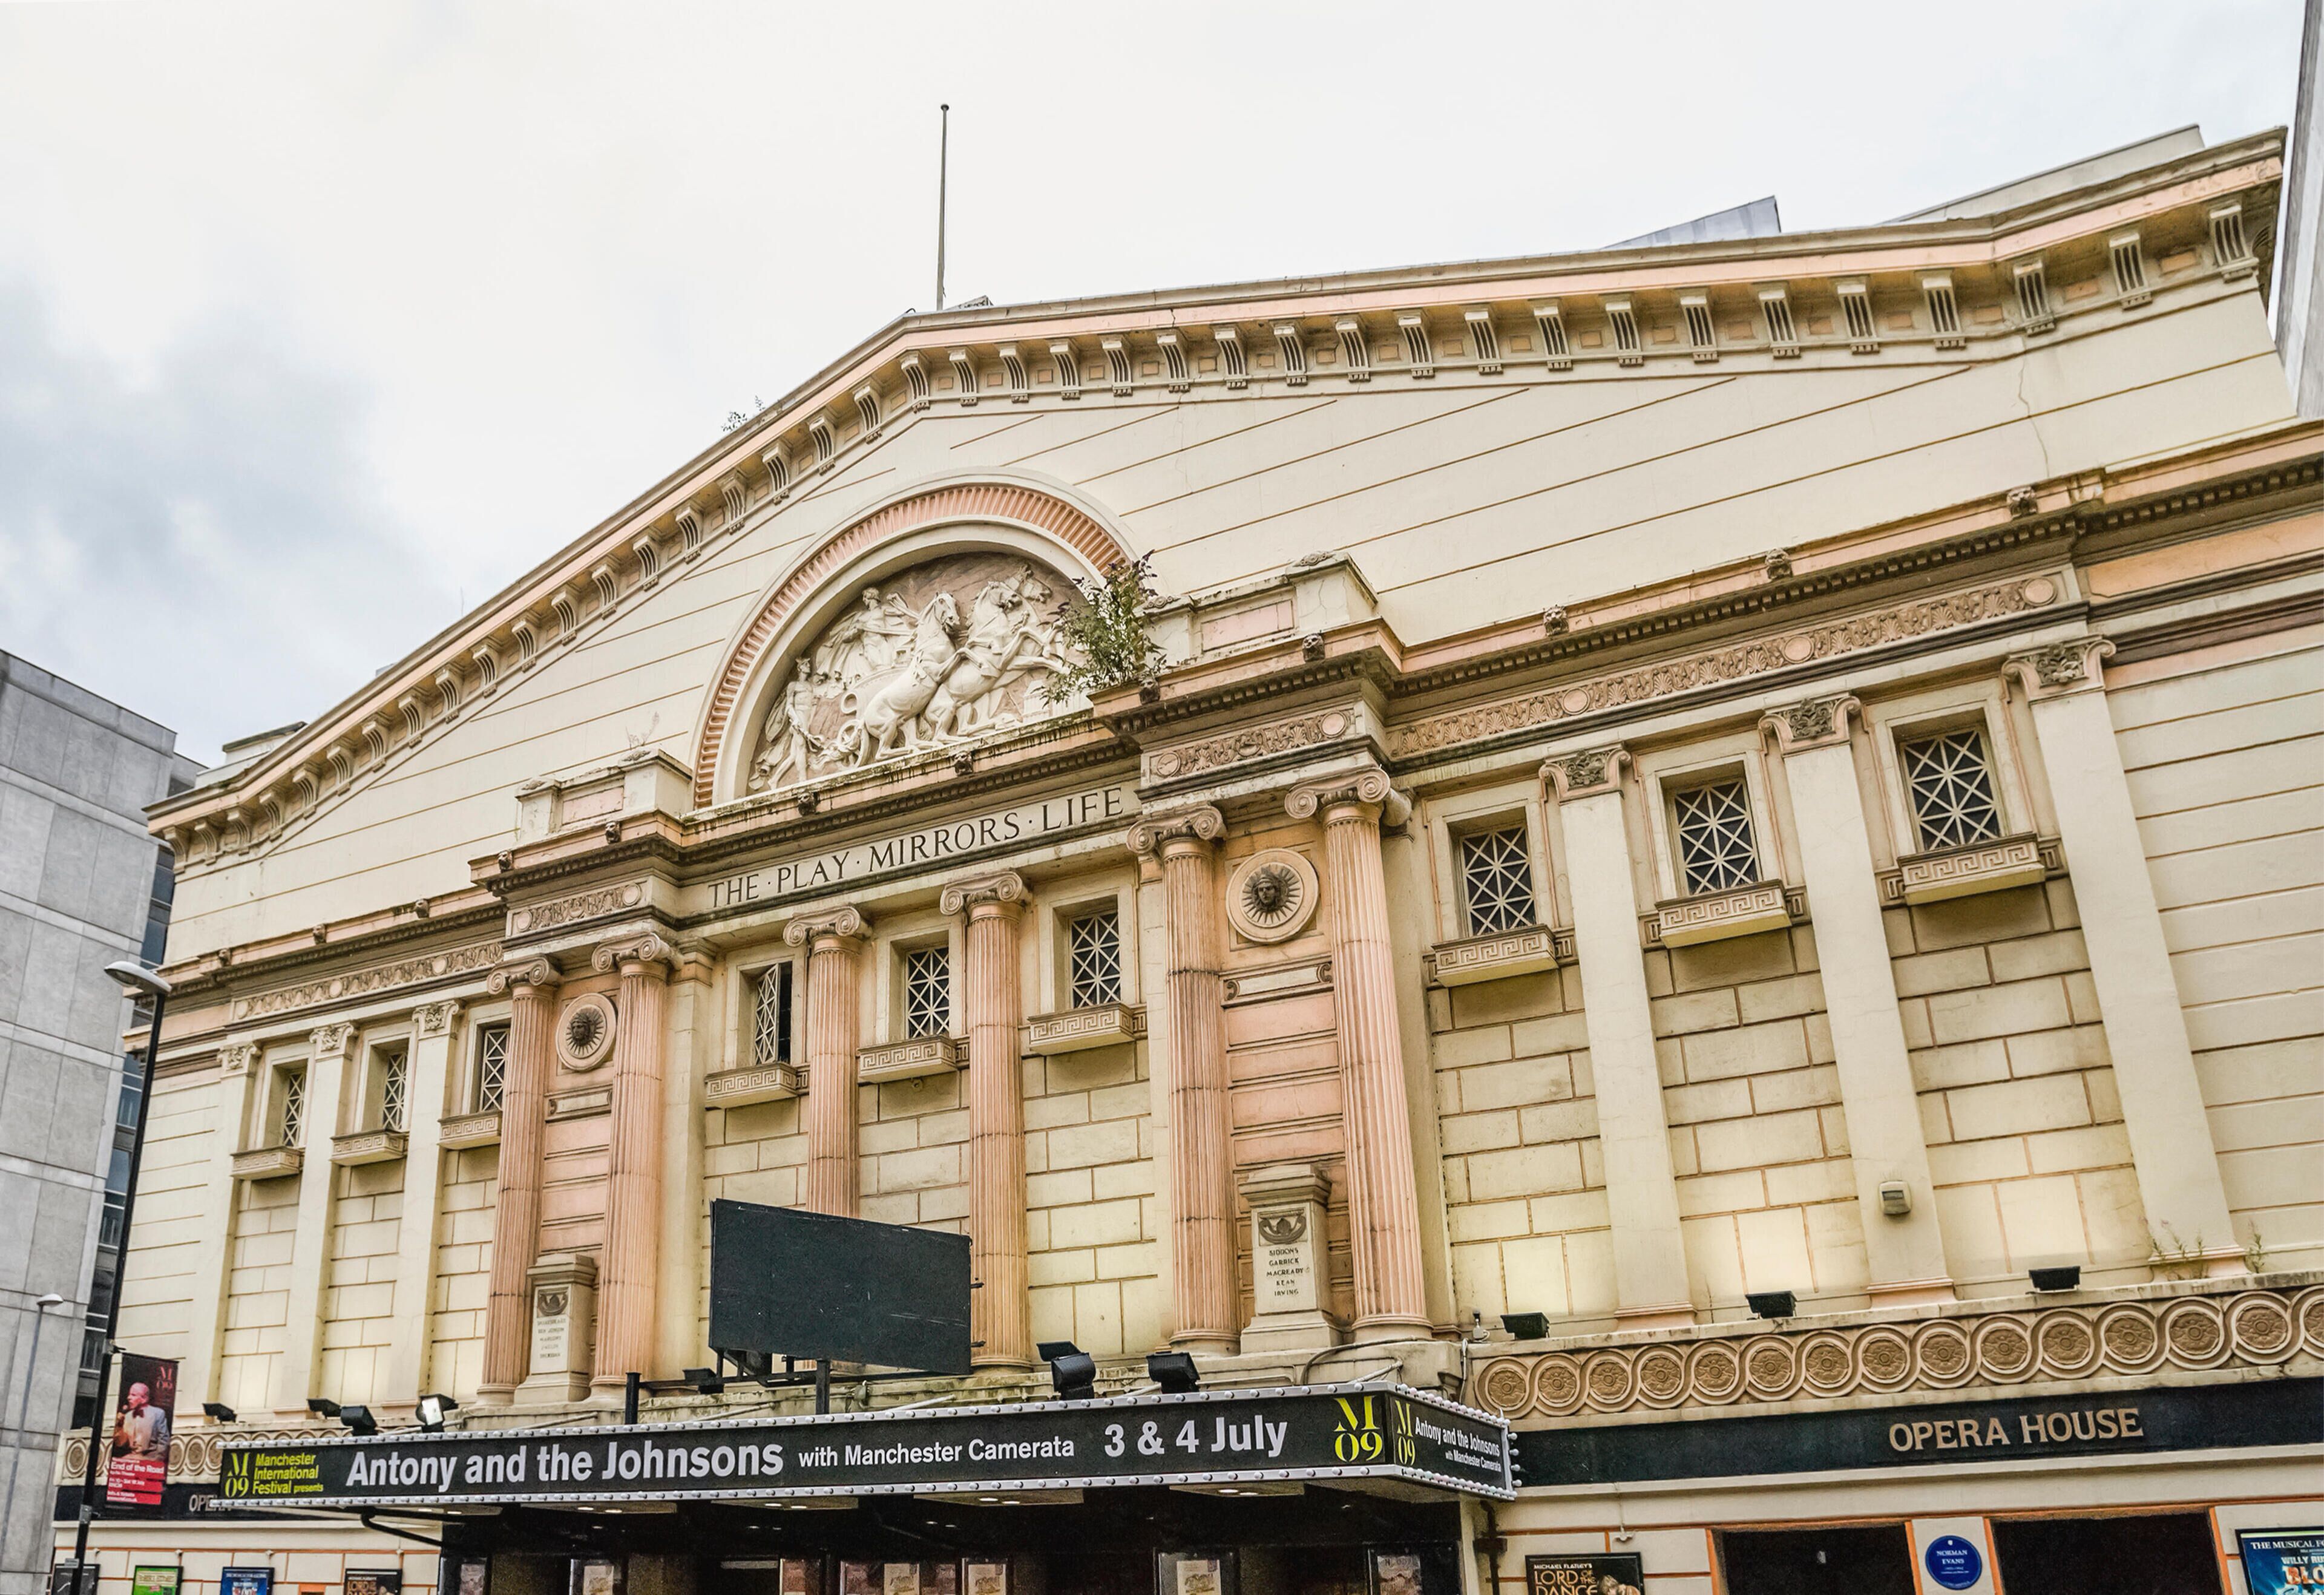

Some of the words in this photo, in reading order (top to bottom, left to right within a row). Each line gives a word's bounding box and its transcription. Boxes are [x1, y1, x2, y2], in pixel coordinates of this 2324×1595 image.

[708, 874, 759, 908] THE
[777, 851, 850, 893] PLAY
[868, 812, 1020, 872] MIRRORS
[1041, 787, 1123, 832] LIFE
[1269, 1247, 1298, 1256] SIDDONS
[1269, 1258, 1299, 1266] GARRICK
[1266, 1268, 1304, 1277] MACREADY
[1415, 1417, 1442, 1445] Antony
[1442, 1427, 1456, 1446] and
[1457, 1430, 1469, 1449] the
[1469, 1433, 1500, 1457] Johnsons
[1889, 1418, 2011, 1452] OPERA
[2019, 1408, 2144, 1443] HOUSE
[346, 1452, 457, 1492] Antony
[465, 1446, 527, 1483] and
[537, 1444, 592, 1481] the
[602, 1440, 783, 1479] Johnsons
[799, 1446, 838, 1467] with
[845, 1441, 962, 1466] Manchester
[968, 1436, 1074, 1461] Camerata
[1105, 1424, 1125, 1457] 3
[1137, 1421, 1165, 1455] &
[1176, 1420, 1199, 1453] 4
[1211, 1415, 1287, 1457] July
[1334, 1432, 1384, 1462] 09
[1398, 1436, 1416, 1466] 09
[255, 1453, 316, 1466] Manchester
[1454, 1450, 1480, 1467] Manchester
[1481, 1456, 1502, 1472] Camerata
[254, 1465, 319, 1480] International
[225, 1477, 249, 1498] 09
[252, 1481, 291, 1495] Festival
[294, 1483, 324, 1494] presents
[2250, 1541, 2271, 1550] THE
[2273, 1539, 2315, 1548] MUSICAL
[2280, 1556, 2309, 1564] WILLY
[1535, 1570, 1579, 1587] LORD
